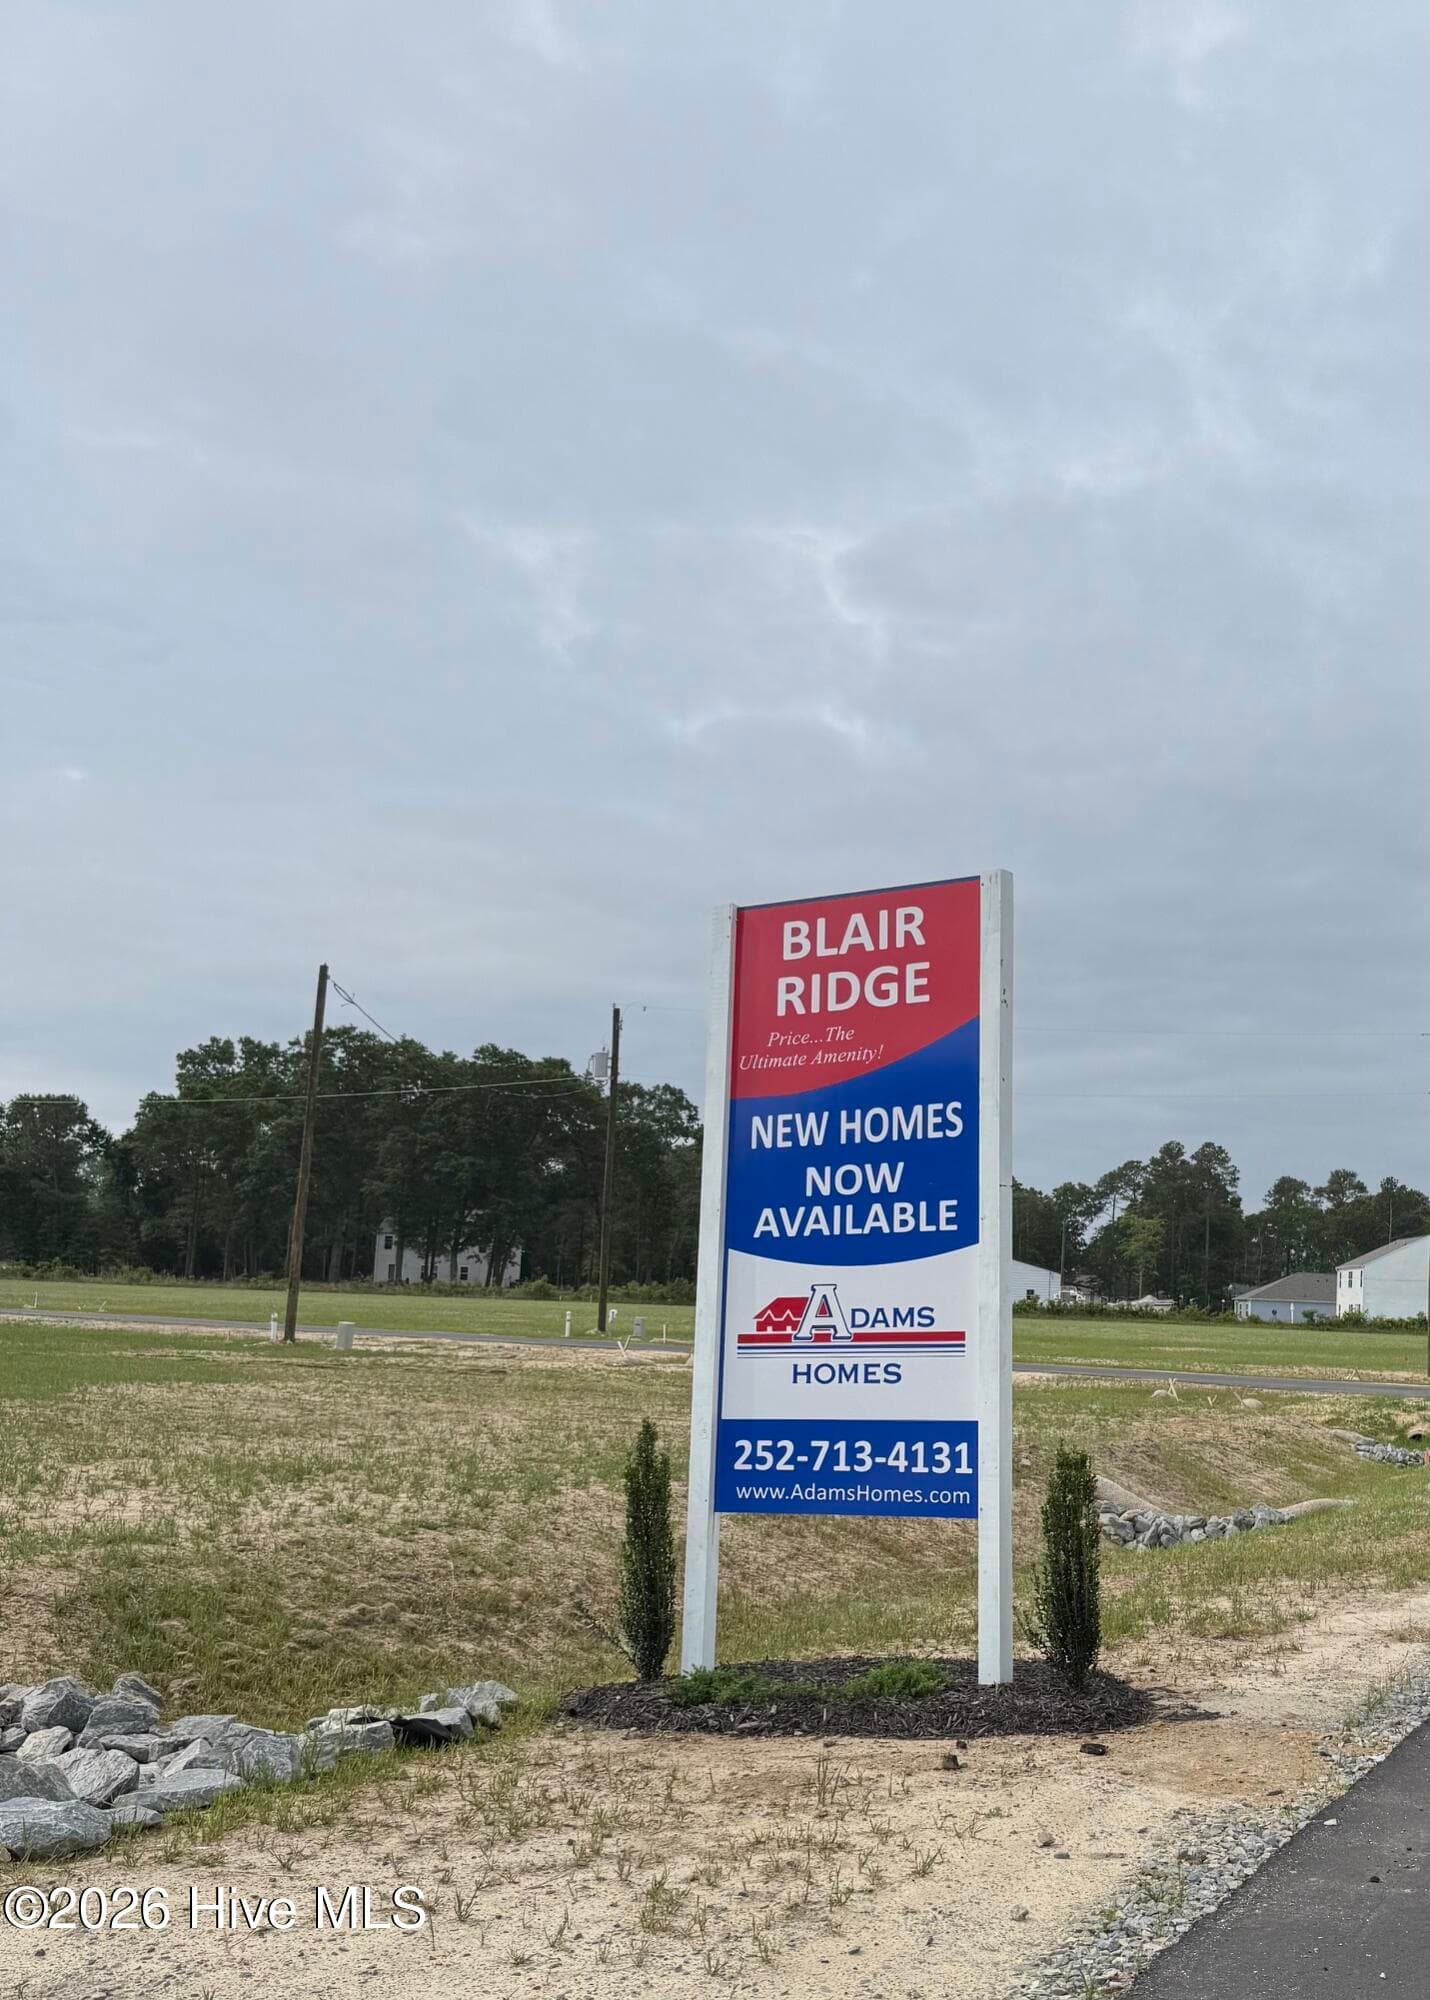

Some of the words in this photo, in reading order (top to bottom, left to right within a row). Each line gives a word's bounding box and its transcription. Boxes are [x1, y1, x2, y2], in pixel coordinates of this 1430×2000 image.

[782, 906, 926, 961] BLAIR
[776, 962, 931, 1017] RIDGE
[767, 1026, 855, 1048] Price...The
[738, 1052, 807, 1071] Ultimate
[811, 1044, 884, 1066] Amenity!
[751, 1111, 829, 1150] NEW
[839, 1101, 964, 1145] HOMES
[805, 1161, 905, 1197] NOW
[753, 1199, 958, 1238] AVAILABLE
[792, 1283, 936, 1341] ADAMS
[792, 1362, 903, 1385] HOMES
[733, 1439, 973, 1474] 252-713-4131
[735, 1483, 971, 1505] www.AdamsHomes.com
